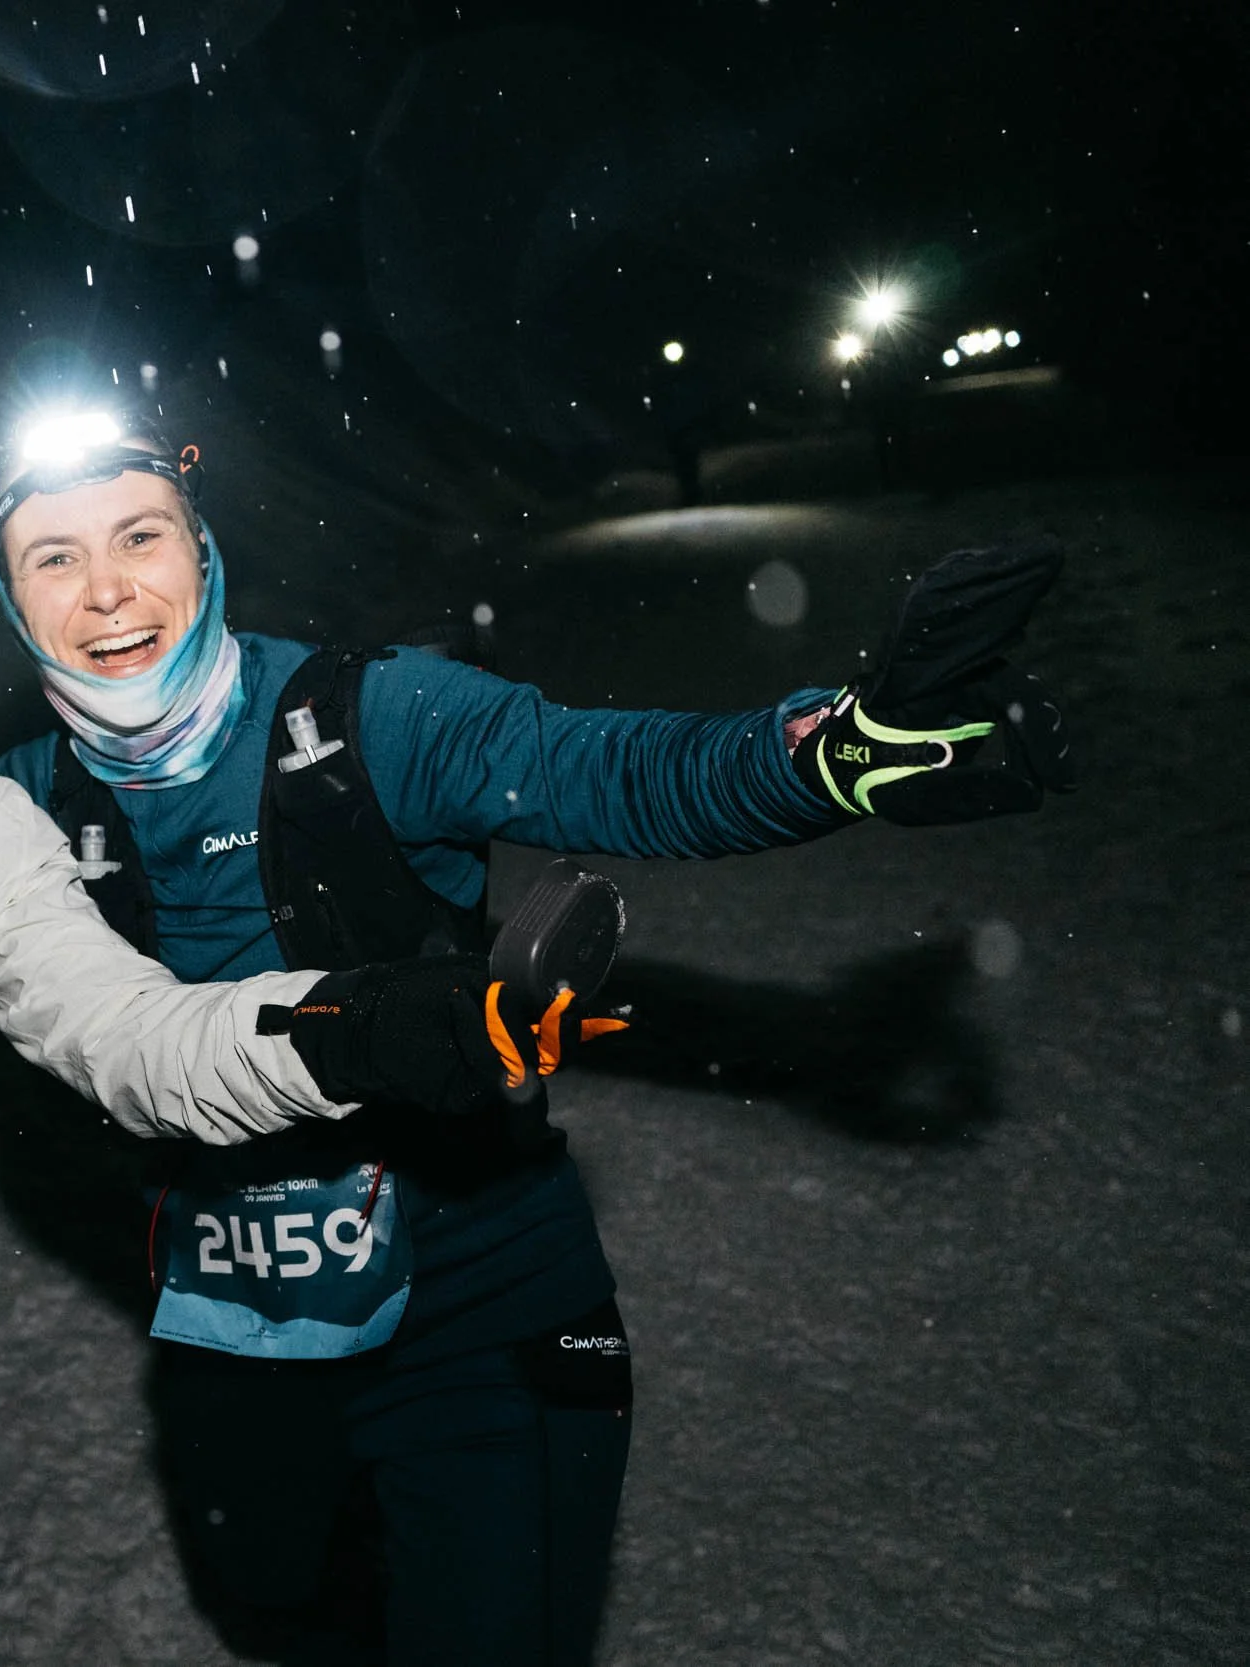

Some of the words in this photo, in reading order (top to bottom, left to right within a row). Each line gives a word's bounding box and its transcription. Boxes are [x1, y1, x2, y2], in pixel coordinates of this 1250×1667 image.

[835, 743, 870, 764] LEKI
[287, 1178, 319, 1191] 10KM
[244, 1194, 254, 1203] 09
[256, 1193, 286, 1202] JANVIER
[194, 1207, 373, 1279] 2459
